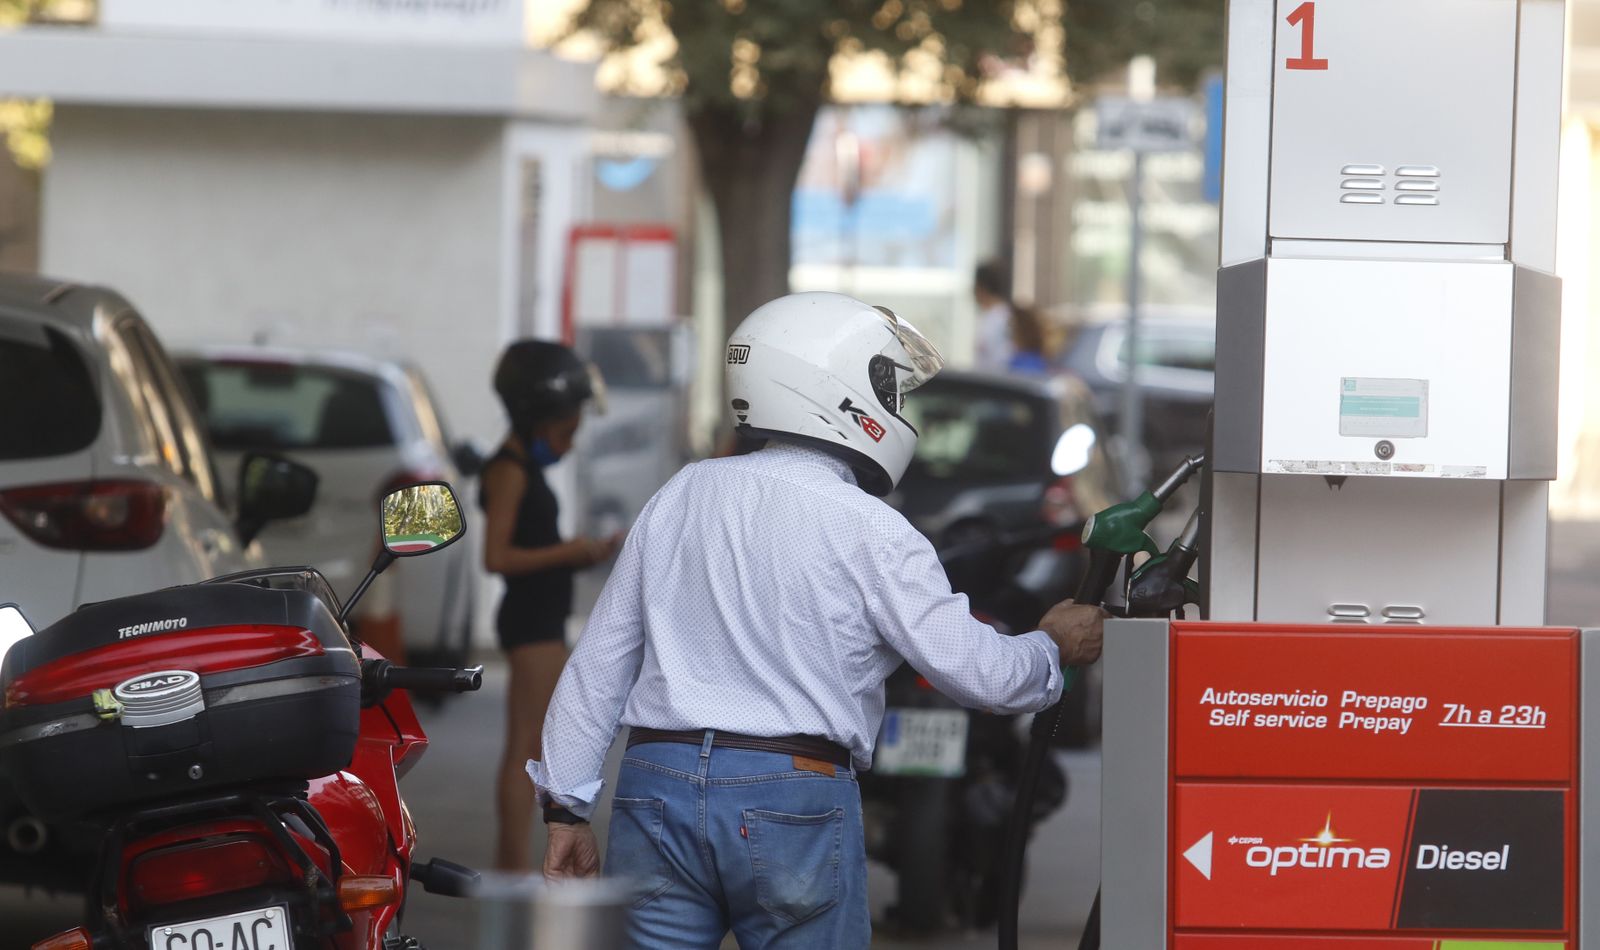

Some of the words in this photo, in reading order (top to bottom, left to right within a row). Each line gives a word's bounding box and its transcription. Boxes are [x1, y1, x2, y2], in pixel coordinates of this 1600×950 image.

[1286, 2, 1328, 70] 1
[118, 617, 188, 639] TECNIMOTO
[129, 676, 185, 691] SHAD
[1200, 688, 1328, 707] Autoservicio
[1340, 691, 1428, 713] Prepago
[1209, 709, 1250, 727] Self
[1253, 711, 1328, 729] service
[1339, 712, 1412, 734] Prepay
[1442, 704, 1471, 723] 7h
[1478, 711, 1492, 724] a
[1499, 705, 1547, 726] 23h
[1246, 843, 1391, 876] optima
[1416, 844, 1510, 870] Diesel
